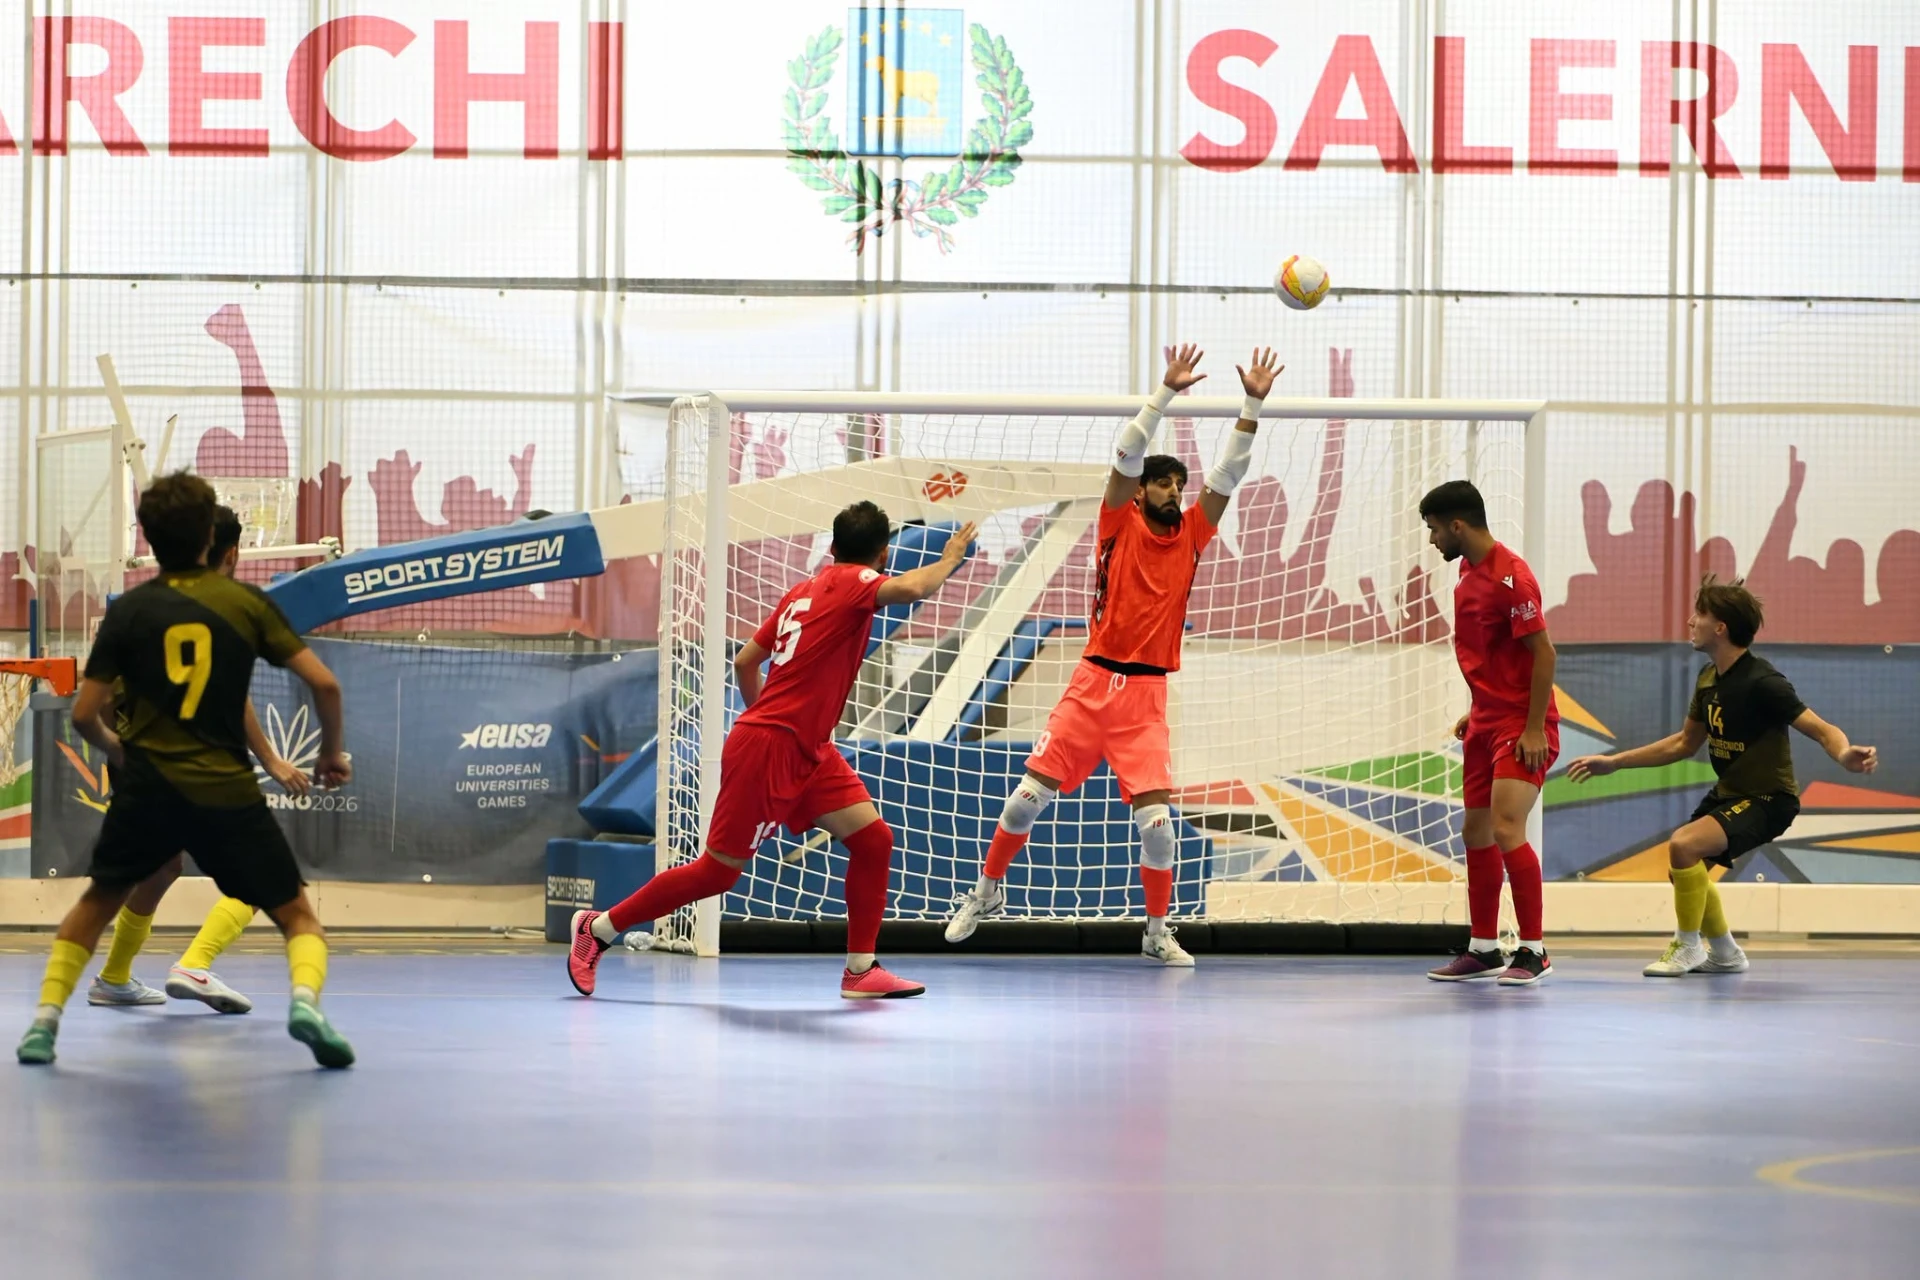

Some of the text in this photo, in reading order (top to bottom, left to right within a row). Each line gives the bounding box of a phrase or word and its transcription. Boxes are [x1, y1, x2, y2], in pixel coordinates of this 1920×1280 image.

[0, 15, 624, 162] RECHI
[164, 623, 212, 720] 9
[1706, 703, 1724, 735] 14
[480, 723, 552, 749] eusa
[467, 763, 542, 777] EUROPEAN
[456, 778, 550, 793] UNIVERSITIES
[264, 793, 358, 812] RNO2026
[477, 796, 527, 809] GAMES
